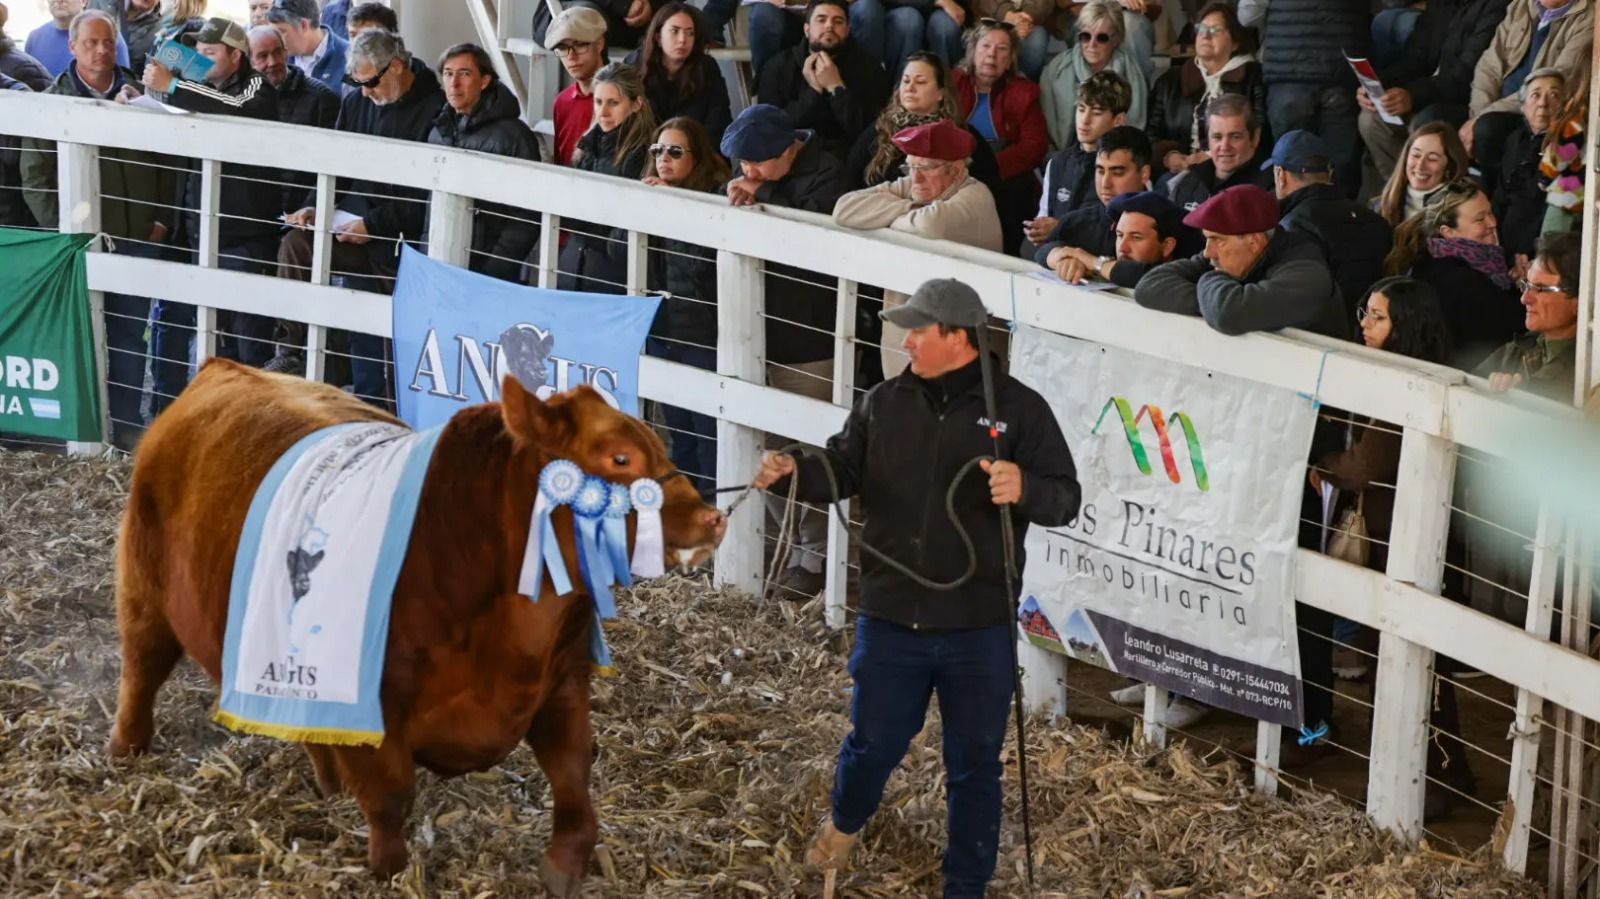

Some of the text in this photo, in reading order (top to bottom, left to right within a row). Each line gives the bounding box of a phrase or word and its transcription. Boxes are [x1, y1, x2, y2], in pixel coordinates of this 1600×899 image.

[0, 355, 59, 391] RD
[976, 416, 1008, 433] ANUS
[1118, 499, 1256, 586] Pinares
[1046, 540, 1247, 626] inmobiliaria
[1124, 631, 1290, 696] Leandro Lusarreta 0291-154447034
[1124, 650, 1156, 668] Martillero
[1160, 662, 1192, 680] Corredor
